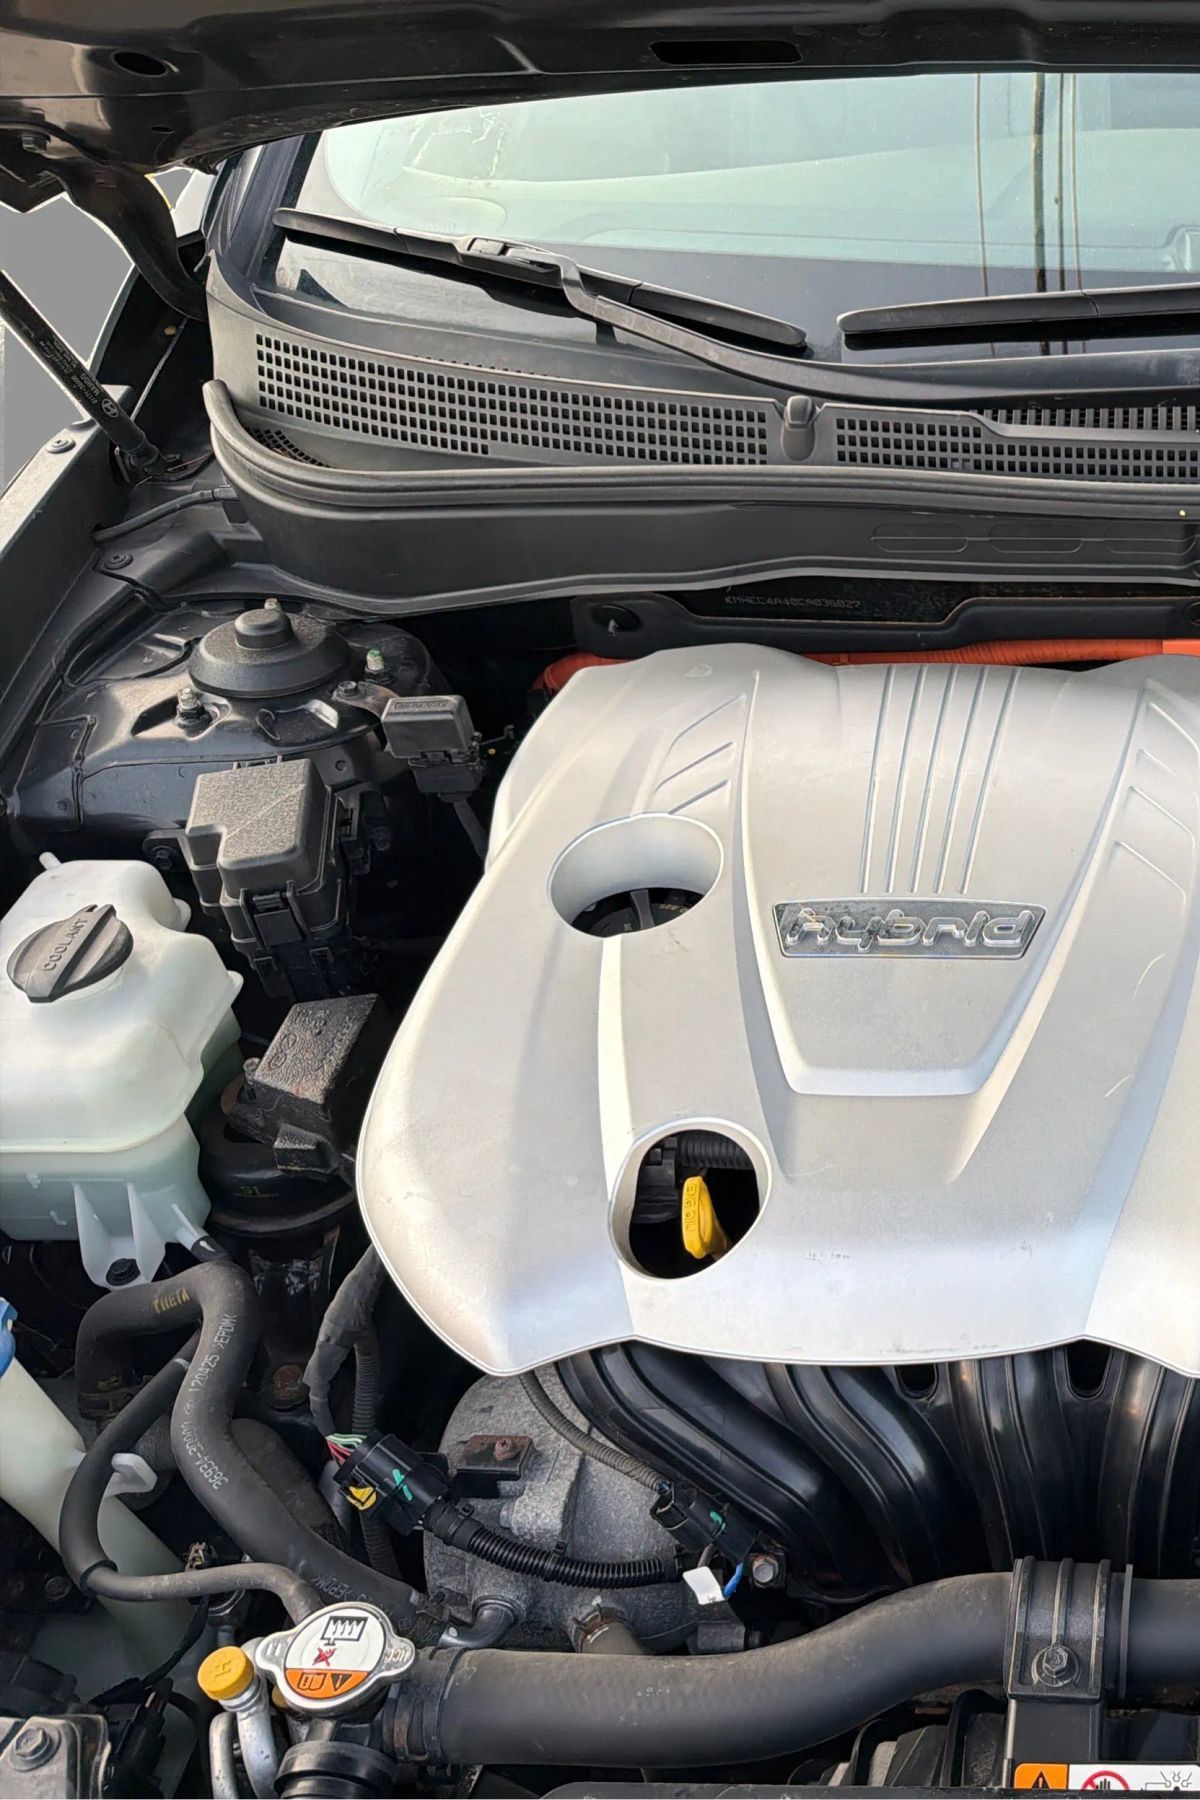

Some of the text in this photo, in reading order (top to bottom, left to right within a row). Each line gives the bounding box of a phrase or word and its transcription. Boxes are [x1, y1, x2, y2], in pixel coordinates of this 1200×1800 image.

[43, 918, 88, 972] COOLANT
[785, 907, 1035, 952] hybrid
[684, 1209, 697, 1232] OIL
[188, 1354, 220, 1393] 120425
